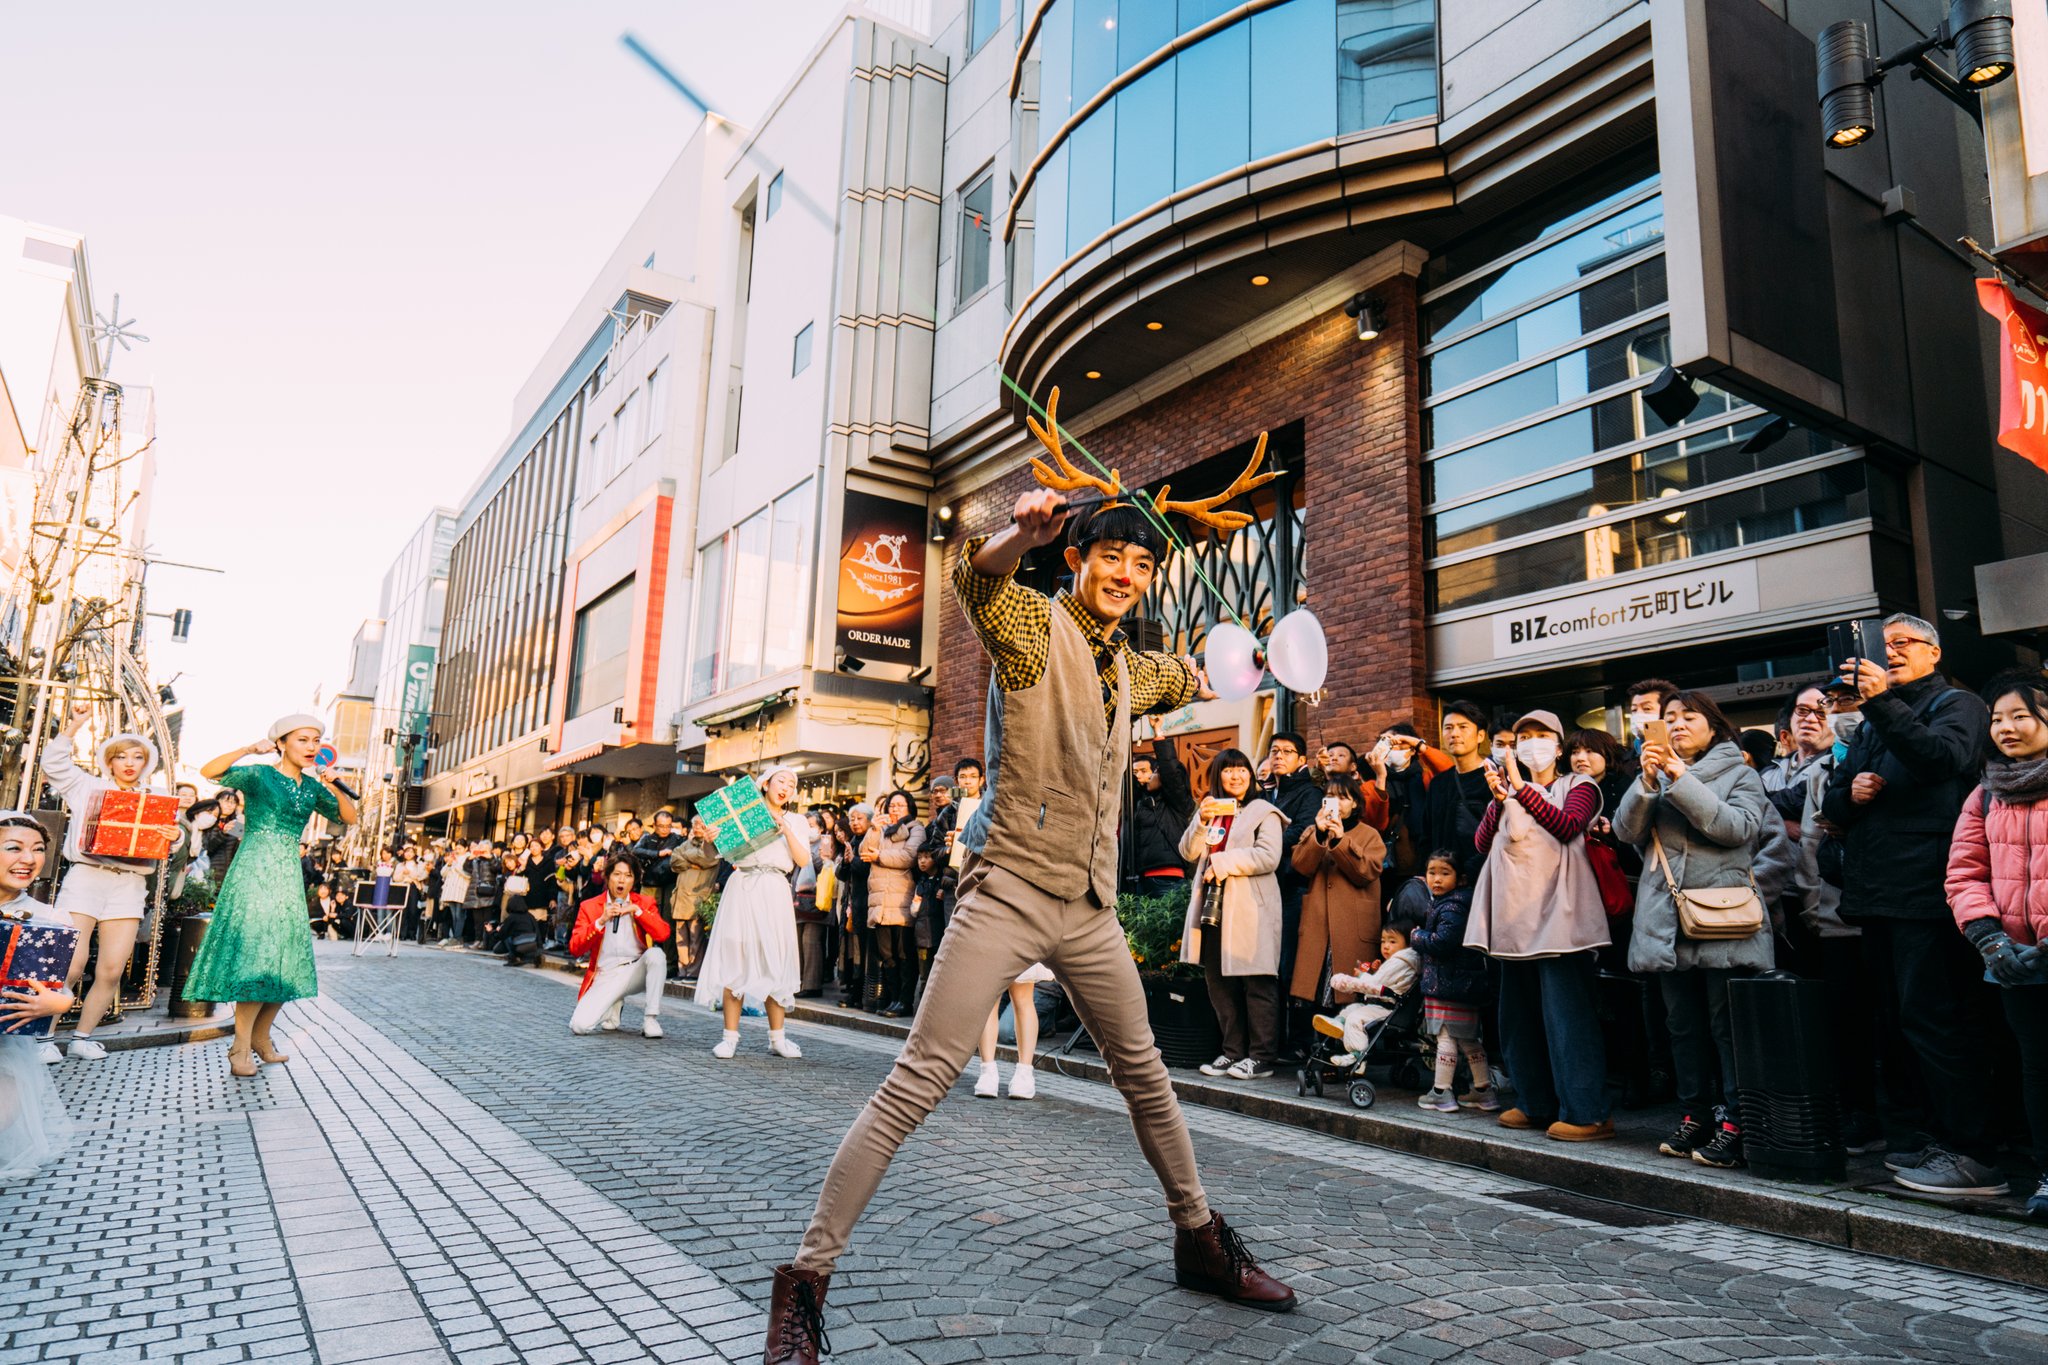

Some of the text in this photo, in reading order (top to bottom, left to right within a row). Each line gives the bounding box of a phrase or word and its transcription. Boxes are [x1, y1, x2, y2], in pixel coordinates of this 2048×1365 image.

[884, 573, 902, 586] 1981
[848, 630, 911, 649] ORDER MADE
